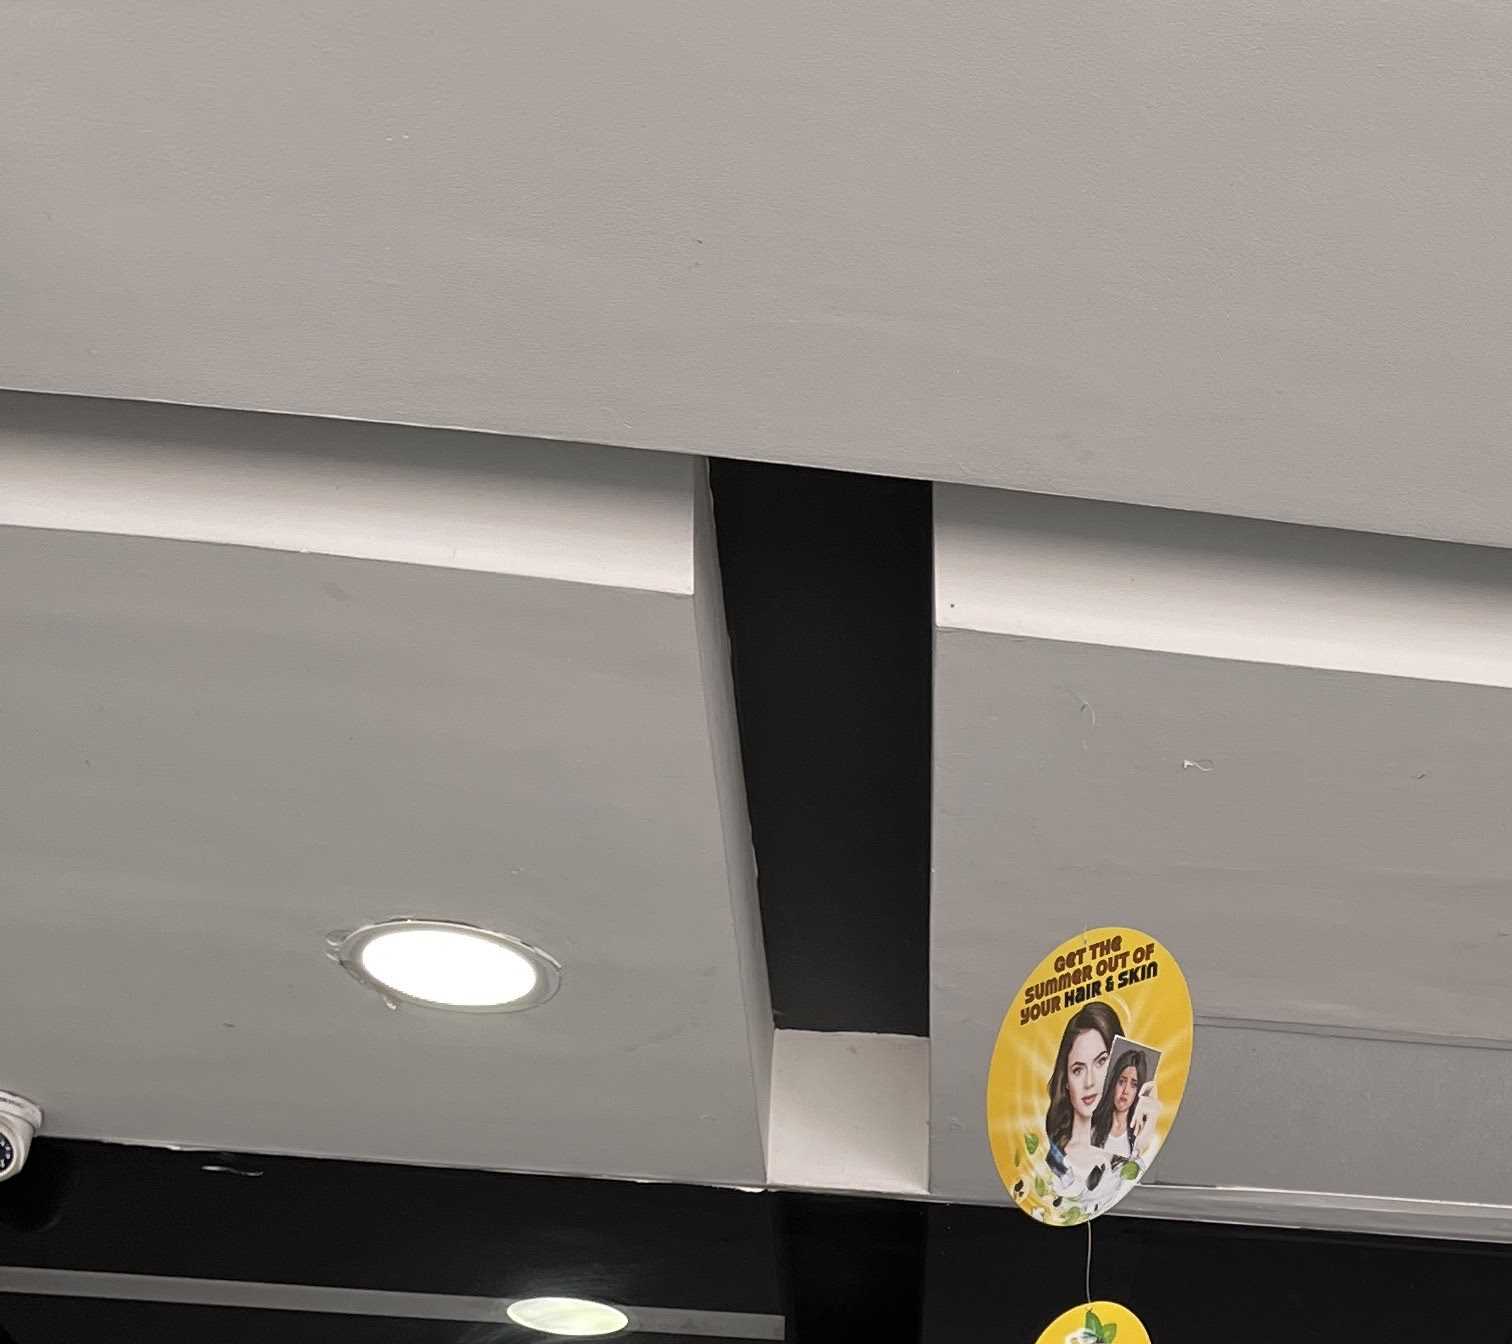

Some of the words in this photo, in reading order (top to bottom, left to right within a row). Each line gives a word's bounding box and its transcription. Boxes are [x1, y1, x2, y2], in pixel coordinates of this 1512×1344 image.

[1095, 952, 1130, 975] OUT
[1132, 943, 1155, 965] OF
[1020, 995, 1062, 1026] YOUR
[1105, 975, 1115, 992] &
